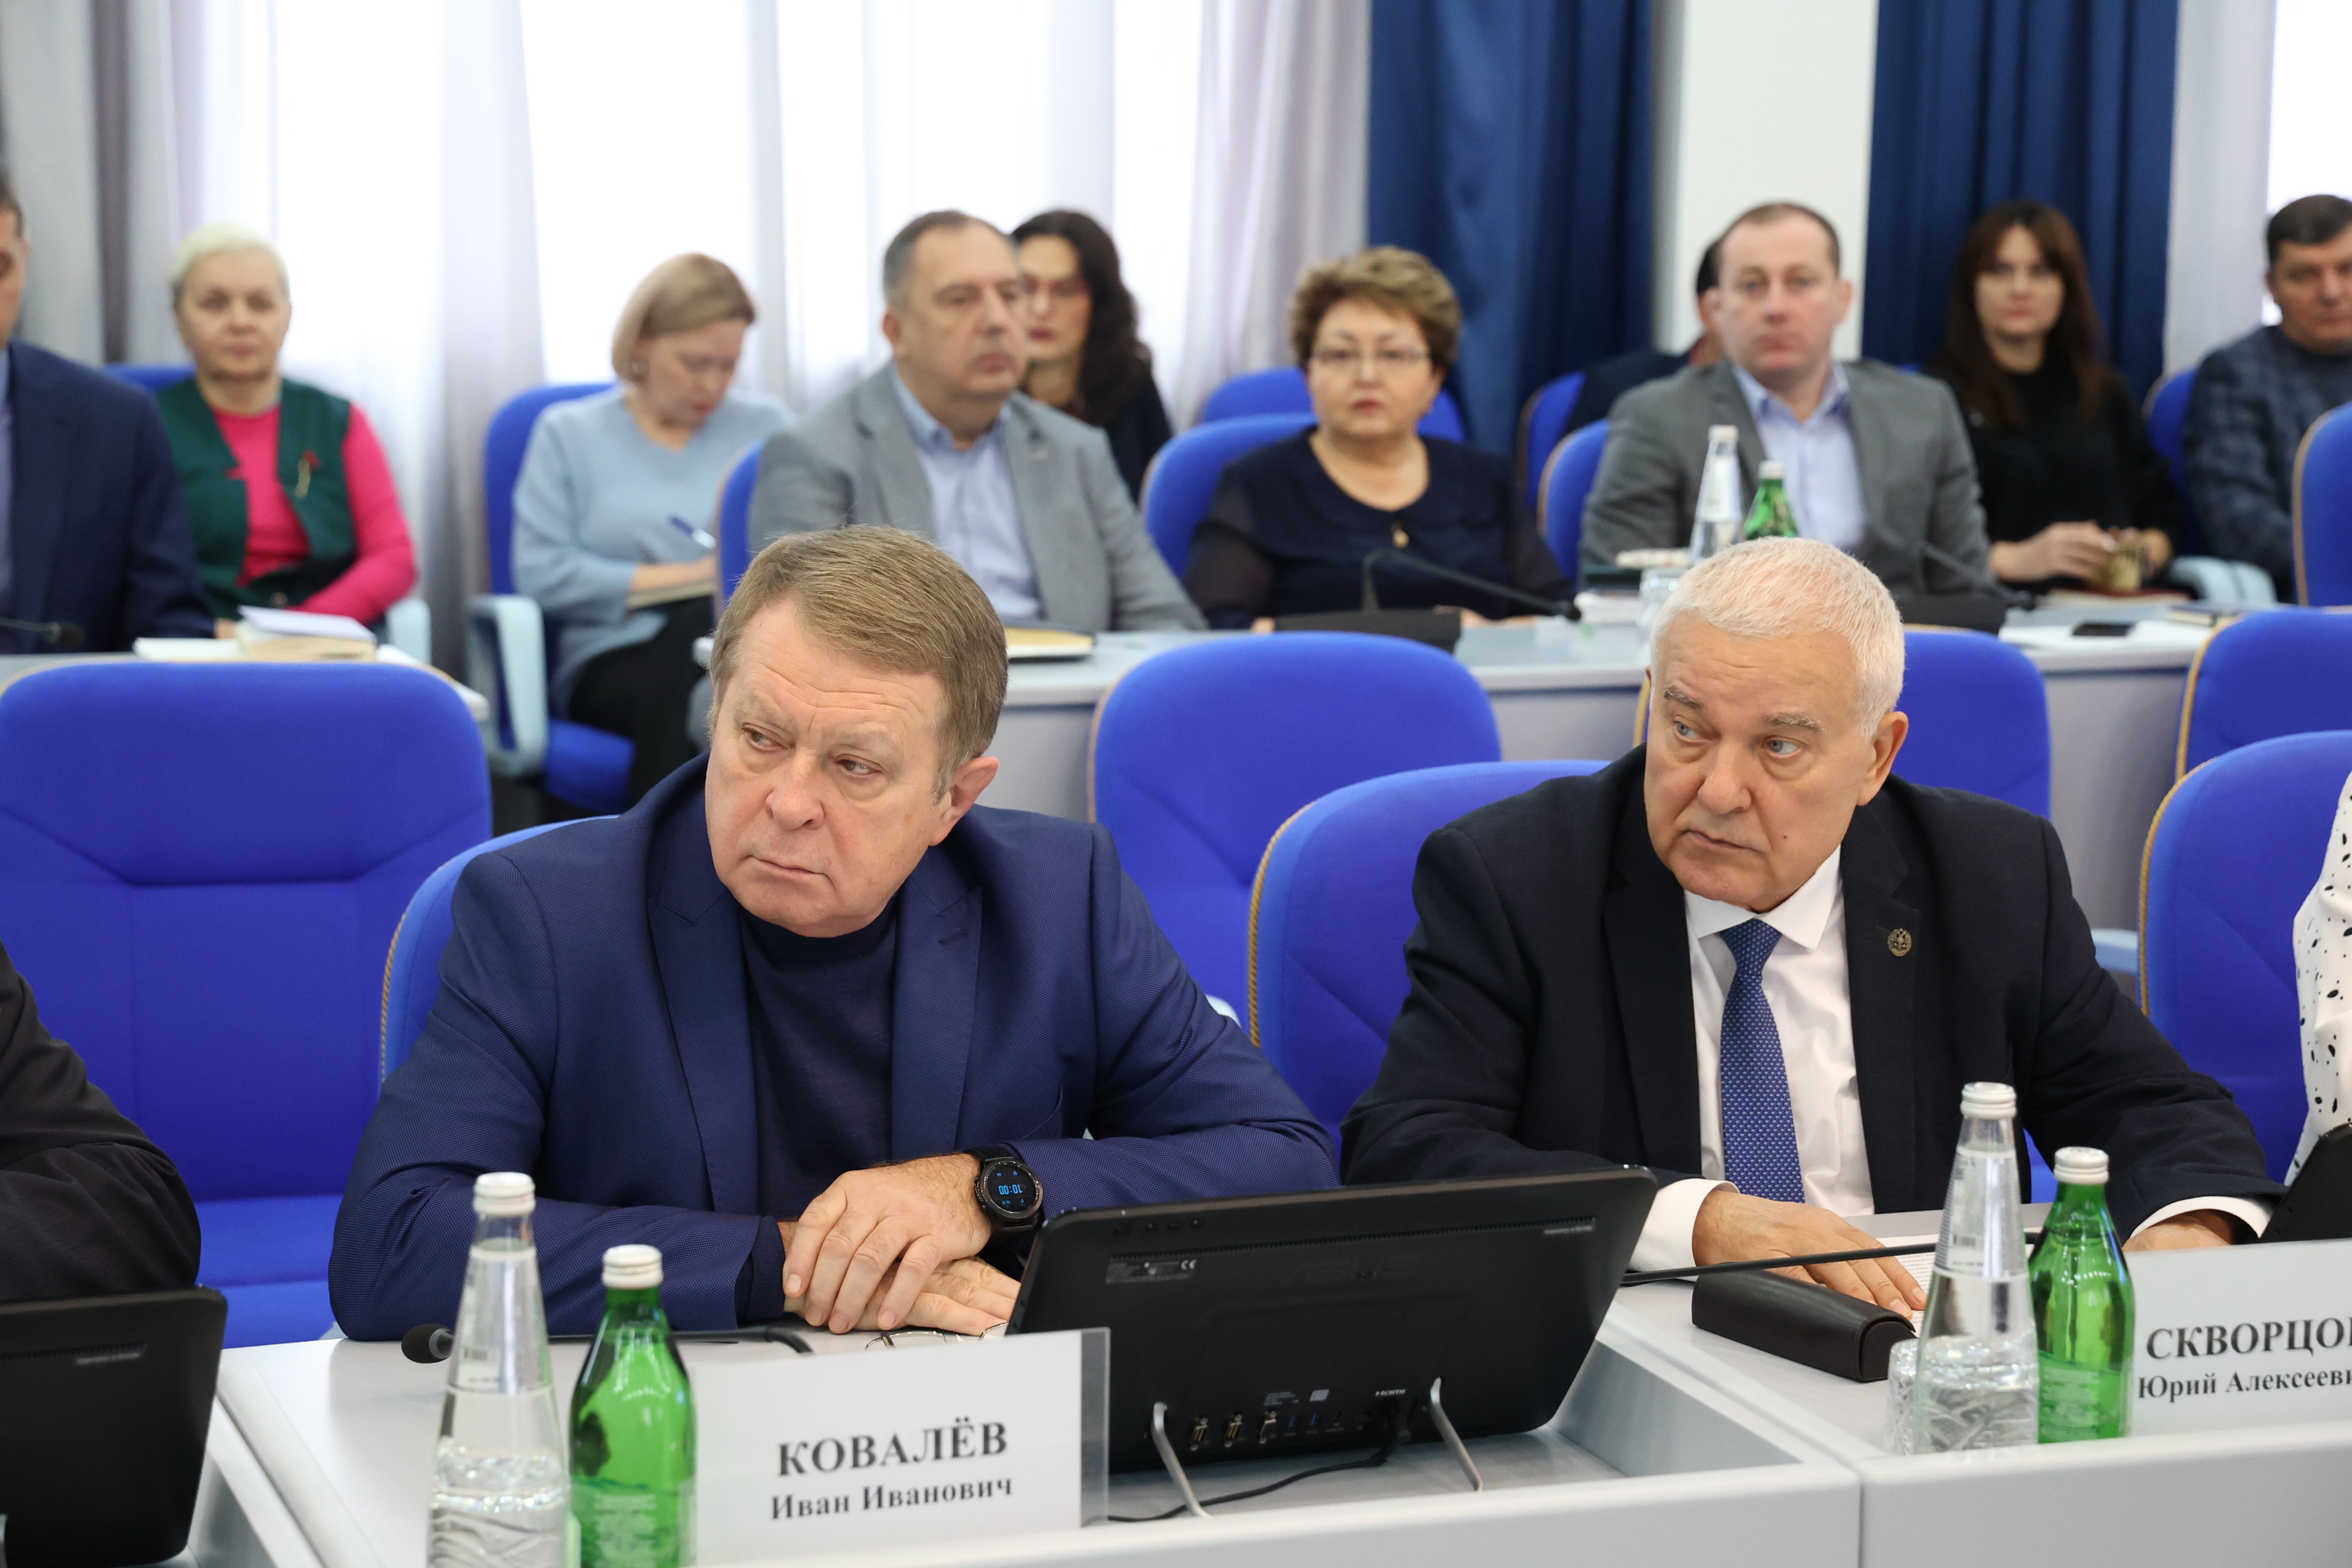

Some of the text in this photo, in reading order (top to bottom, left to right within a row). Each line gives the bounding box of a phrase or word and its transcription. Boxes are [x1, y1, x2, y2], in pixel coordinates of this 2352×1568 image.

[998, 1184, 1023, 1195] 10:00
[2146, 1317, 2352, 1360] СКВОРЦО
[2138, 1372, 2217, 1403] Юрий
[778, 1416, 1008, 1477] КОВАЛЁВ
[772, 1478, 1012, 1521] Иван Иванович
